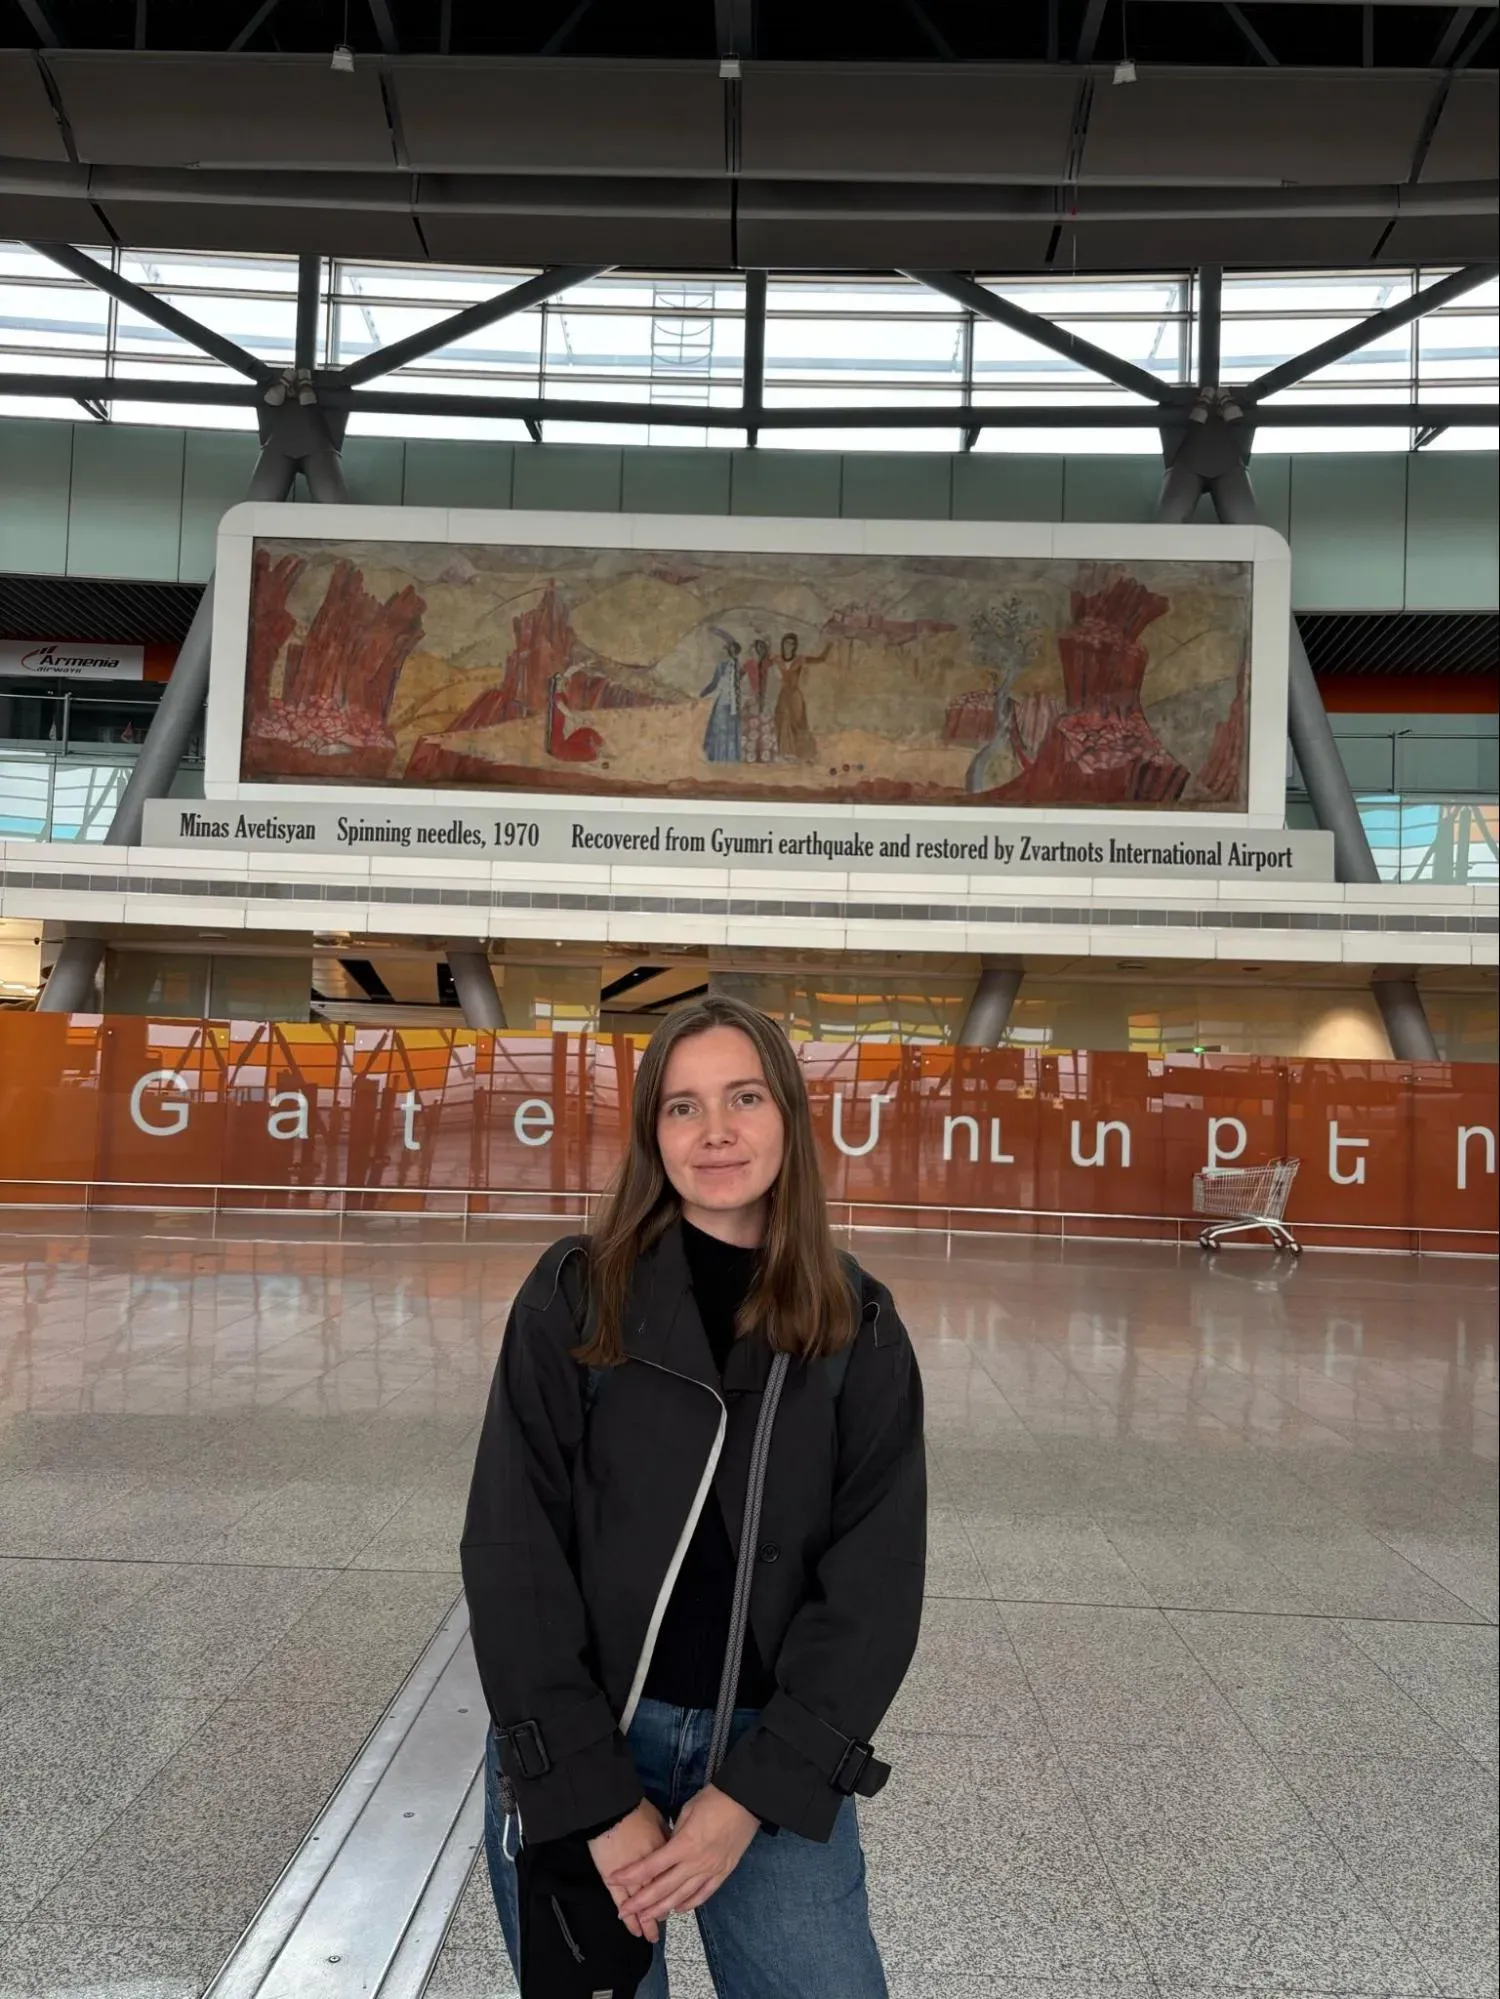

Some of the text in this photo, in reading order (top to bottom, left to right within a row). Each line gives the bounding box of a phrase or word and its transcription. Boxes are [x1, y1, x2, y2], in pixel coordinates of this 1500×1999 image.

[39, 655, 120, 668] Armenia
[180, 813, 1292, 871] Minas Avetisyan Spinning needles, 1970 Recovered from Gyumri earthquake and restored by Zvartnots International Airport
